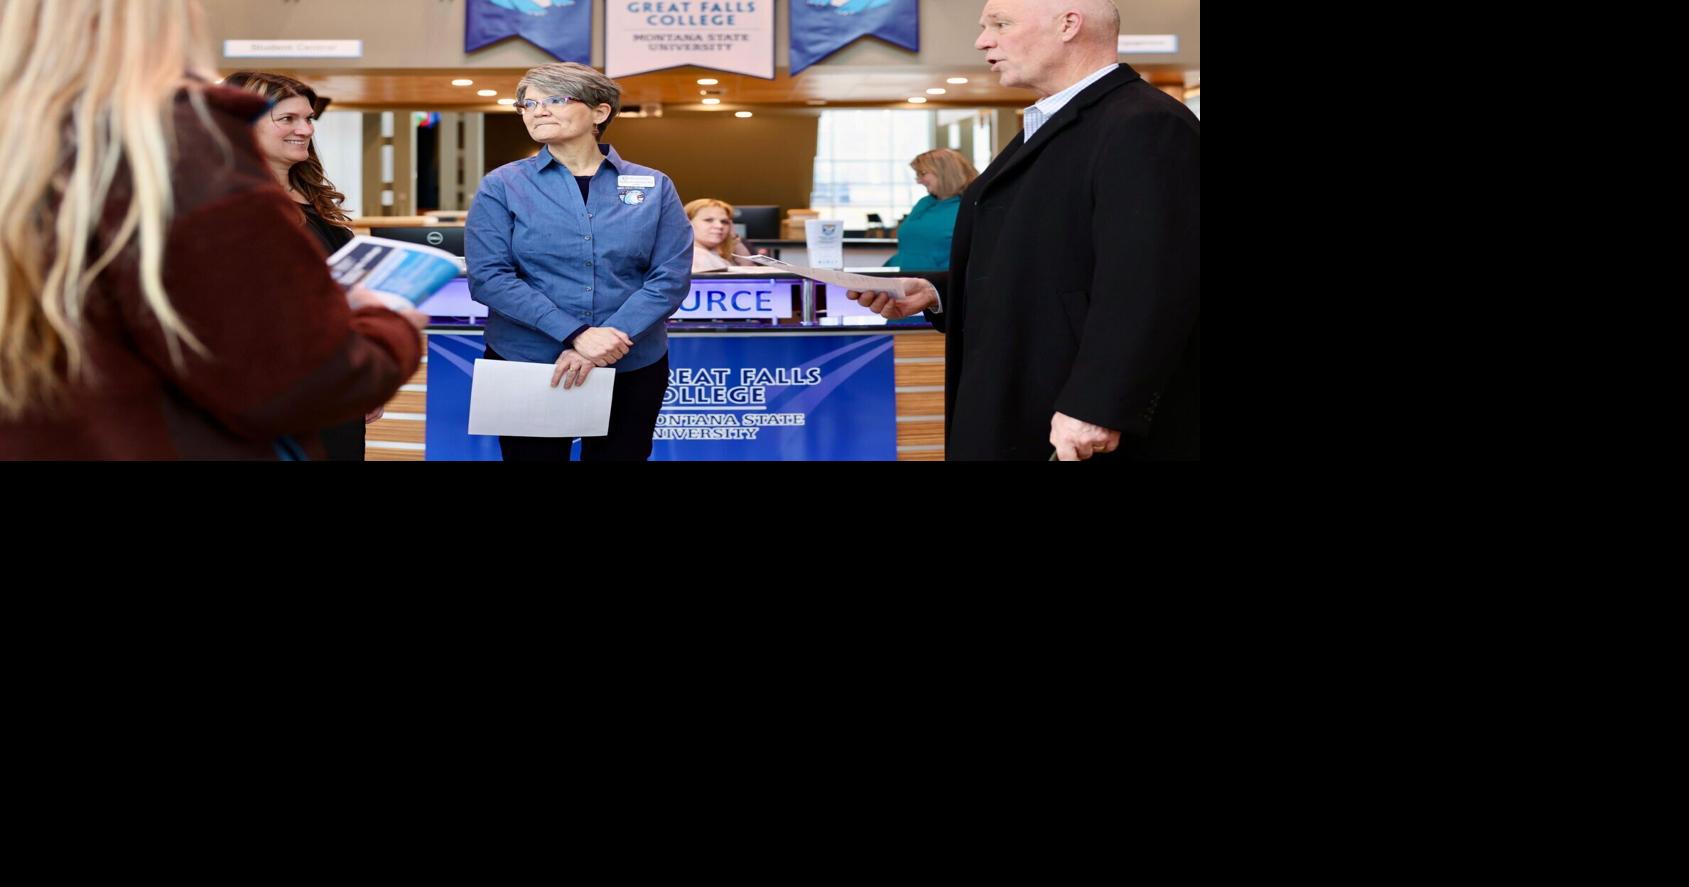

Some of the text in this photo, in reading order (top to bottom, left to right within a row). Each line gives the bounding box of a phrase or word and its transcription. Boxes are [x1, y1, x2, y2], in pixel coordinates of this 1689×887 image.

[627, 1, 756, 13] GREAT FALLS
[646, 14, 736, 26] COLLEGE
[633, 34, 749, 42] MONTANA STATE
[648, 43, 733, 51] UNIVERSITY
[679, 290, 773, 312] URCE
[668, 368, 821, 386] REAT FALLS
[662, 386, 766, 404] OLLEGE
[655, 413, 805, 427] ONTANA STATE
[652, 427, 760, 440] NIVERSITY
